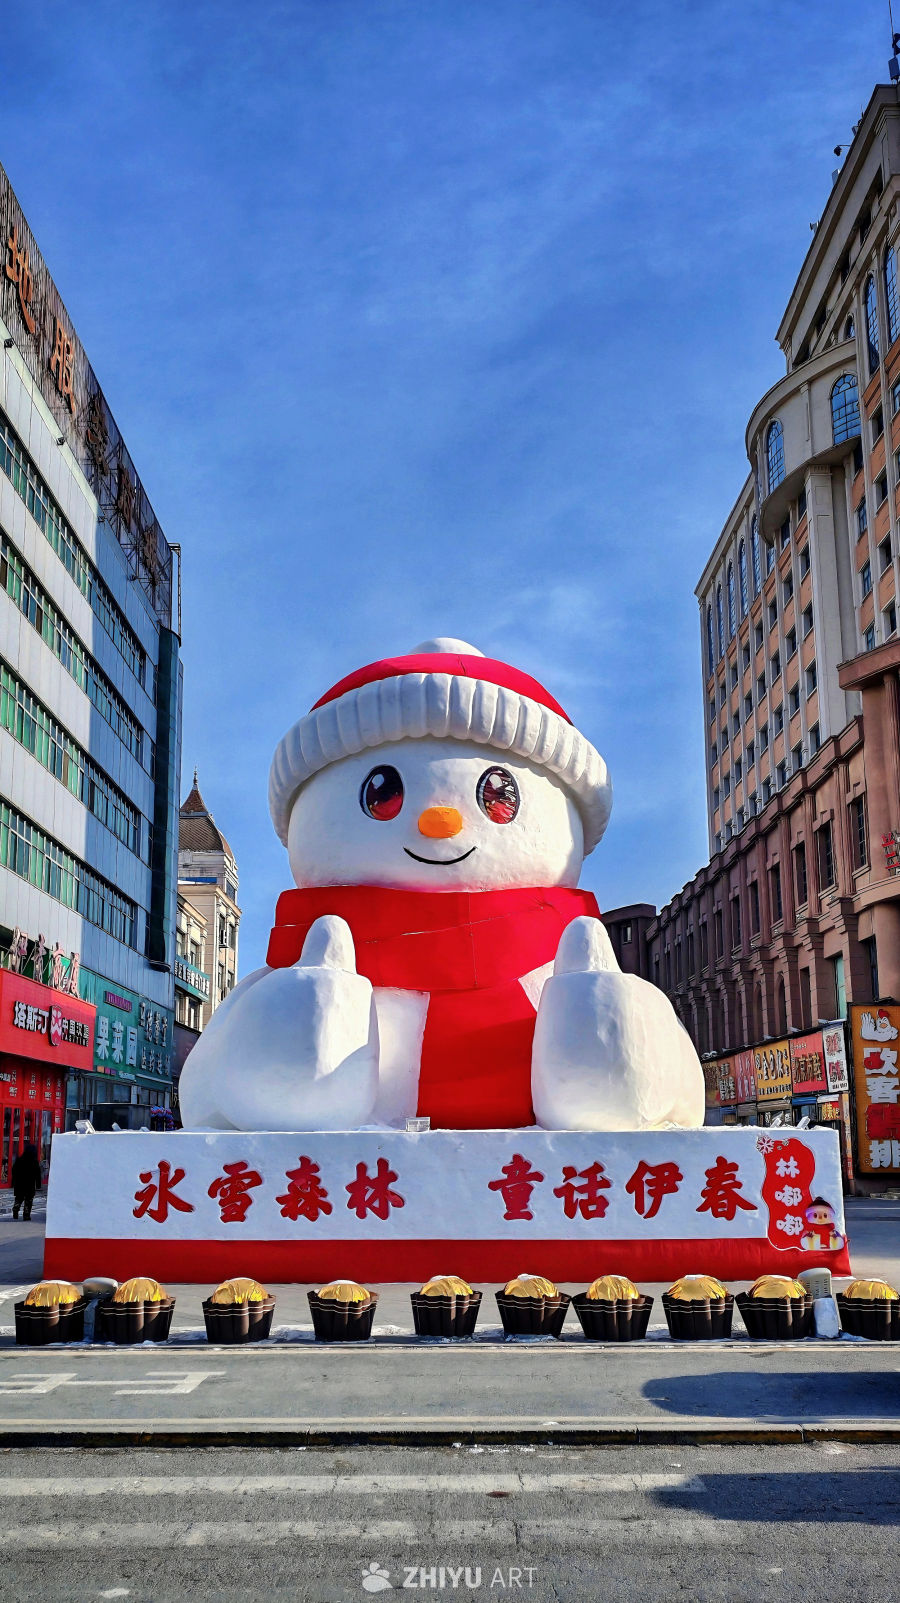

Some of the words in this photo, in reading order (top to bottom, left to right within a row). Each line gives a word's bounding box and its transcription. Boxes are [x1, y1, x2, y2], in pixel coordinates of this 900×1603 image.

[14, 1001, 49, 1034] 塔斯汀
[96, 1015, 138, 1067] 果菜园
[488, 1153, 758, 1221] 童话伊春
[775, 1155, 804, 1236] 林嘟嘟
